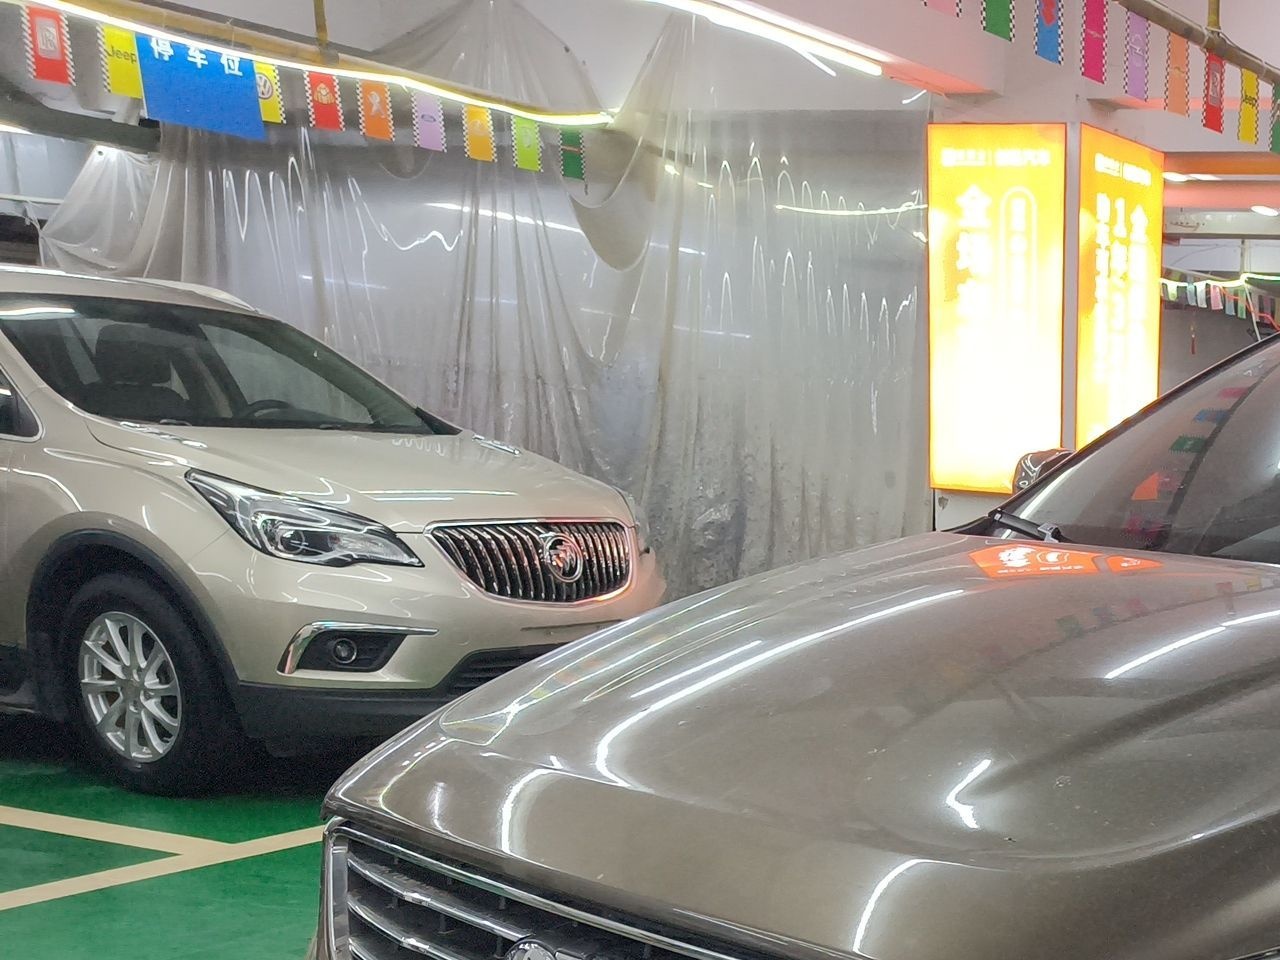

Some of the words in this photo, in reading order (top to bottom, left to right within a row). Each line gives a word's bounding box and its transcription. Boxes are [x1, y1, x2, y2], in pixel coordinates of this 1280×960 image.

[106, 47, 137, 64] Jeep
[150, 37, 243, 76] 停车位
